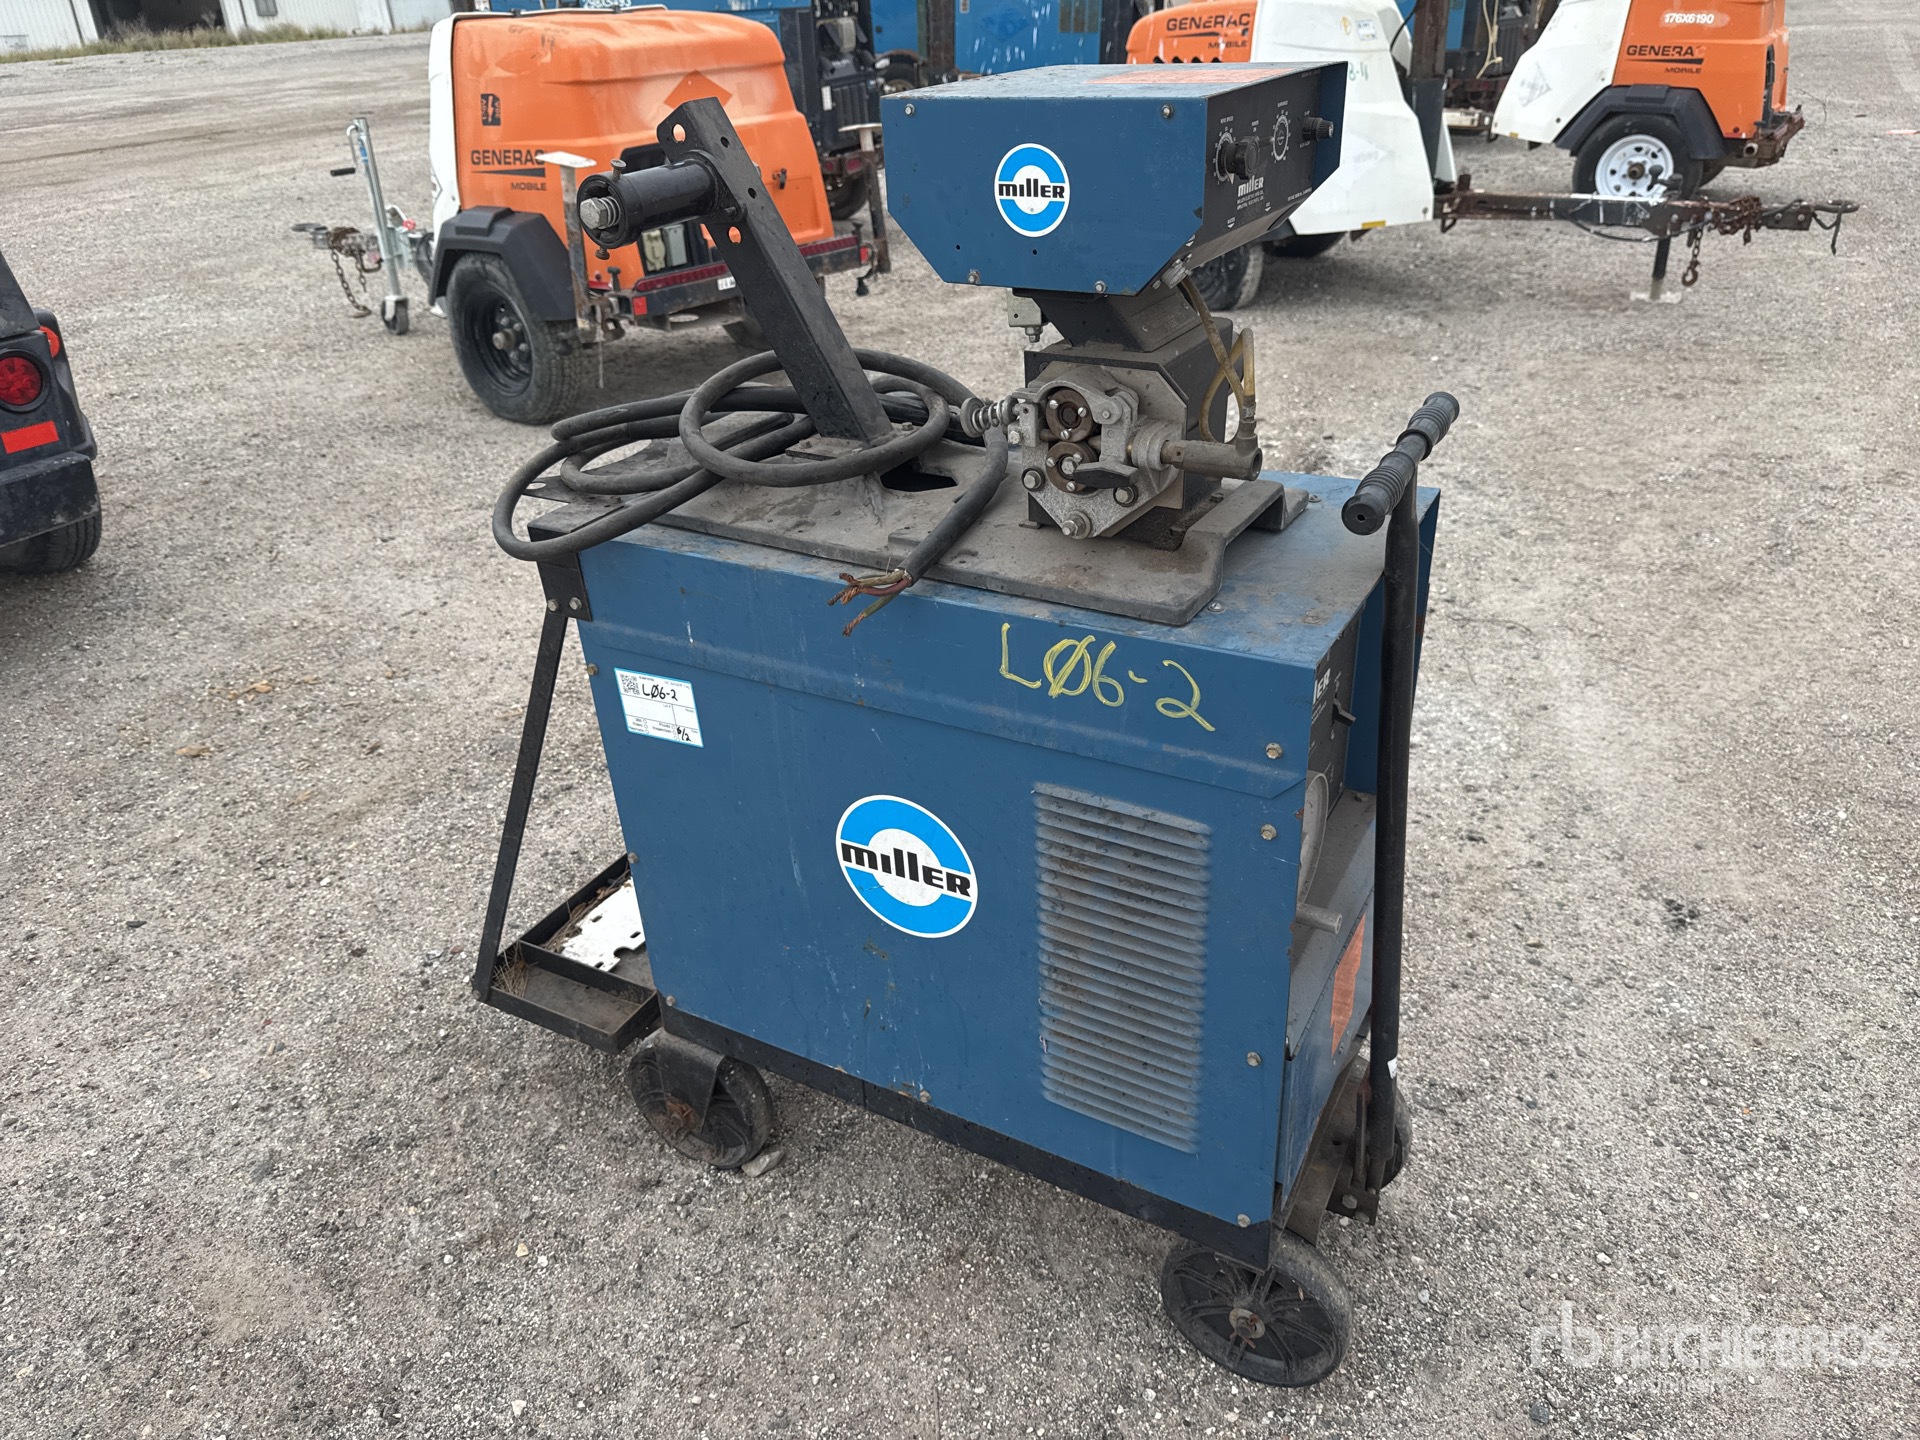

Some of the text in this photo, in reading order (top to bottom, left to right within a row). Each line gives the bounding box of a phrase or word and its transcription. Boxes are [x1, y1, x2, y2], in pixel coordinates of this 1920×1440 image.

[1166, 13, 1250, 31] GENERAC
[1664, 13, 1715, 24] 176X6190
[511, 182, 547, 191] MOBILE
